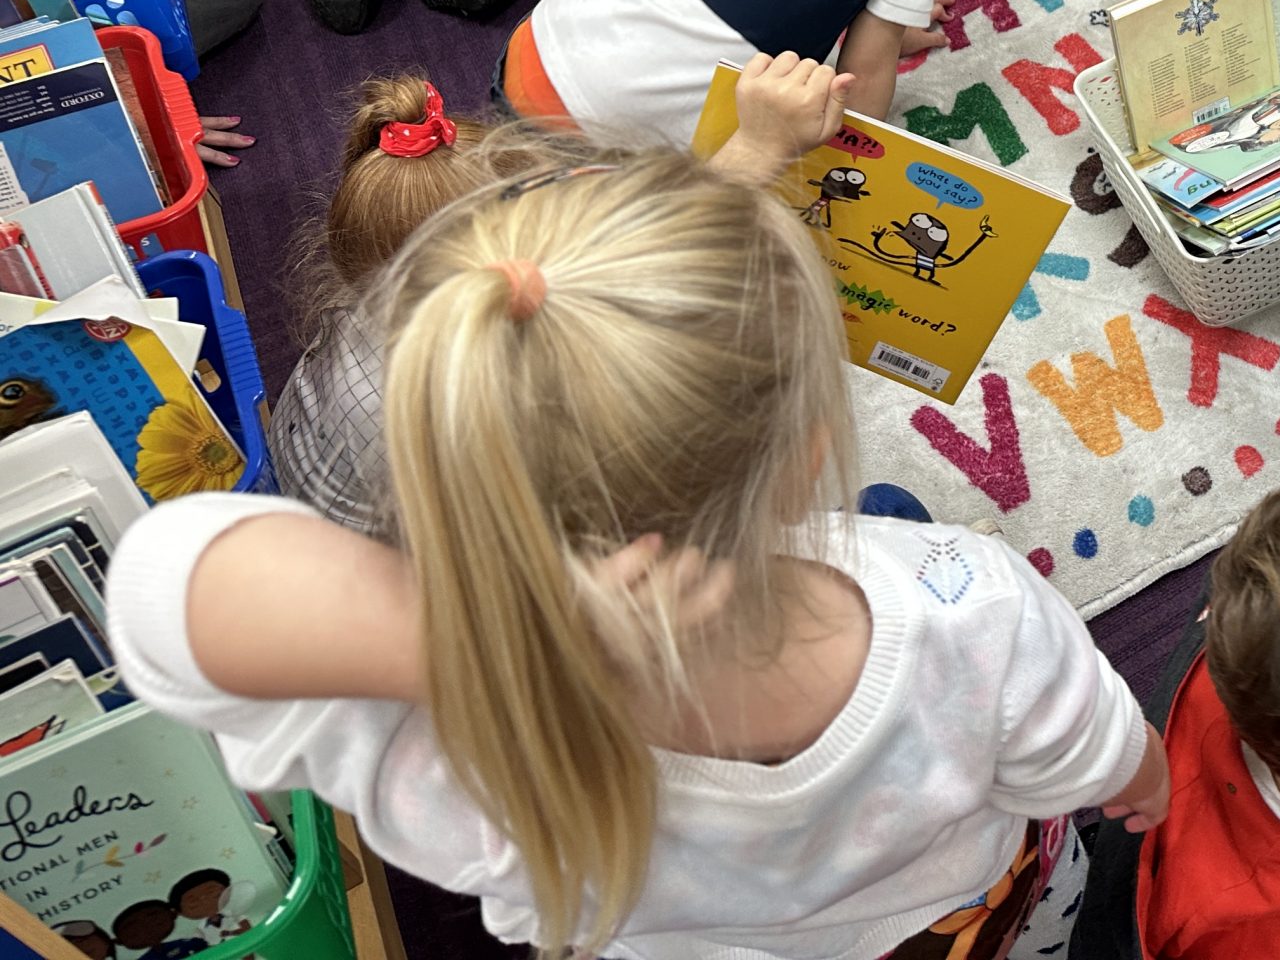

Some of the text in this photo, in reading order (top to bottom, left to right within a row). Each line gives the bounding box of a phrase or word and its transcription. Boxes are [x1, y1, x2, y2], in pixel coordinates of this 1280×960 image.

[60, 89, 104, 109] OXFORD
[914, 177, 978, 205] you say?
[954, 179, 969, 192] do
[840, 285, 956, 336] magic word?
[0, 785, 154, 862] Leaders
[76, 830, 119, 856] MEN
[25, 887, 49, 903] IN
[37, 875, 122, 921] HISTORY
